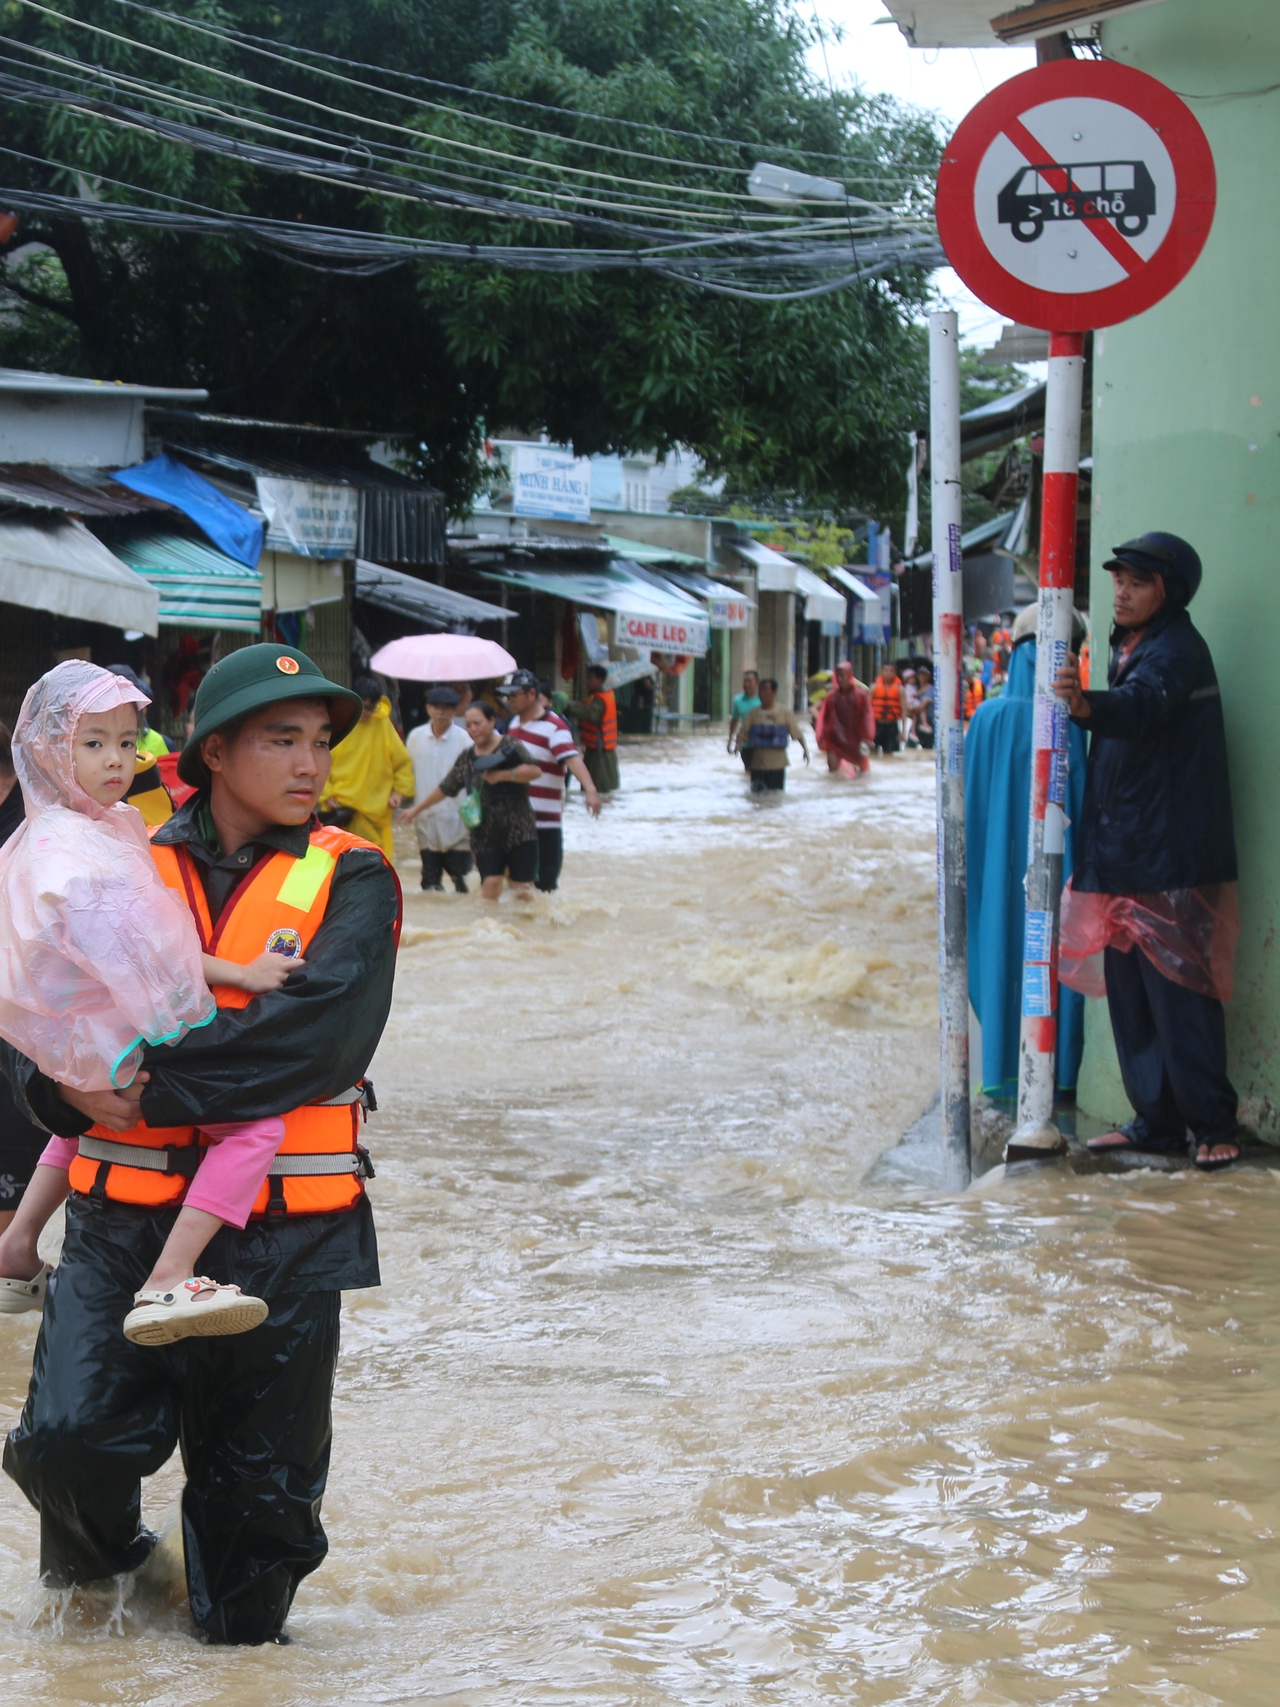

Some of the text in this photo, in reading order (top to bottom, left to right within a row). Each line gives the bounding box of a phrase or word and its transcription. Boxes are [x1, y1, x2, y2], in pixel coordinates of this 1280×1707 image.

[1049, 198, 1077, 217] 16
[519, 472, 549, 490] MINH
[627, 618, 688, 644] CAFE LEO
